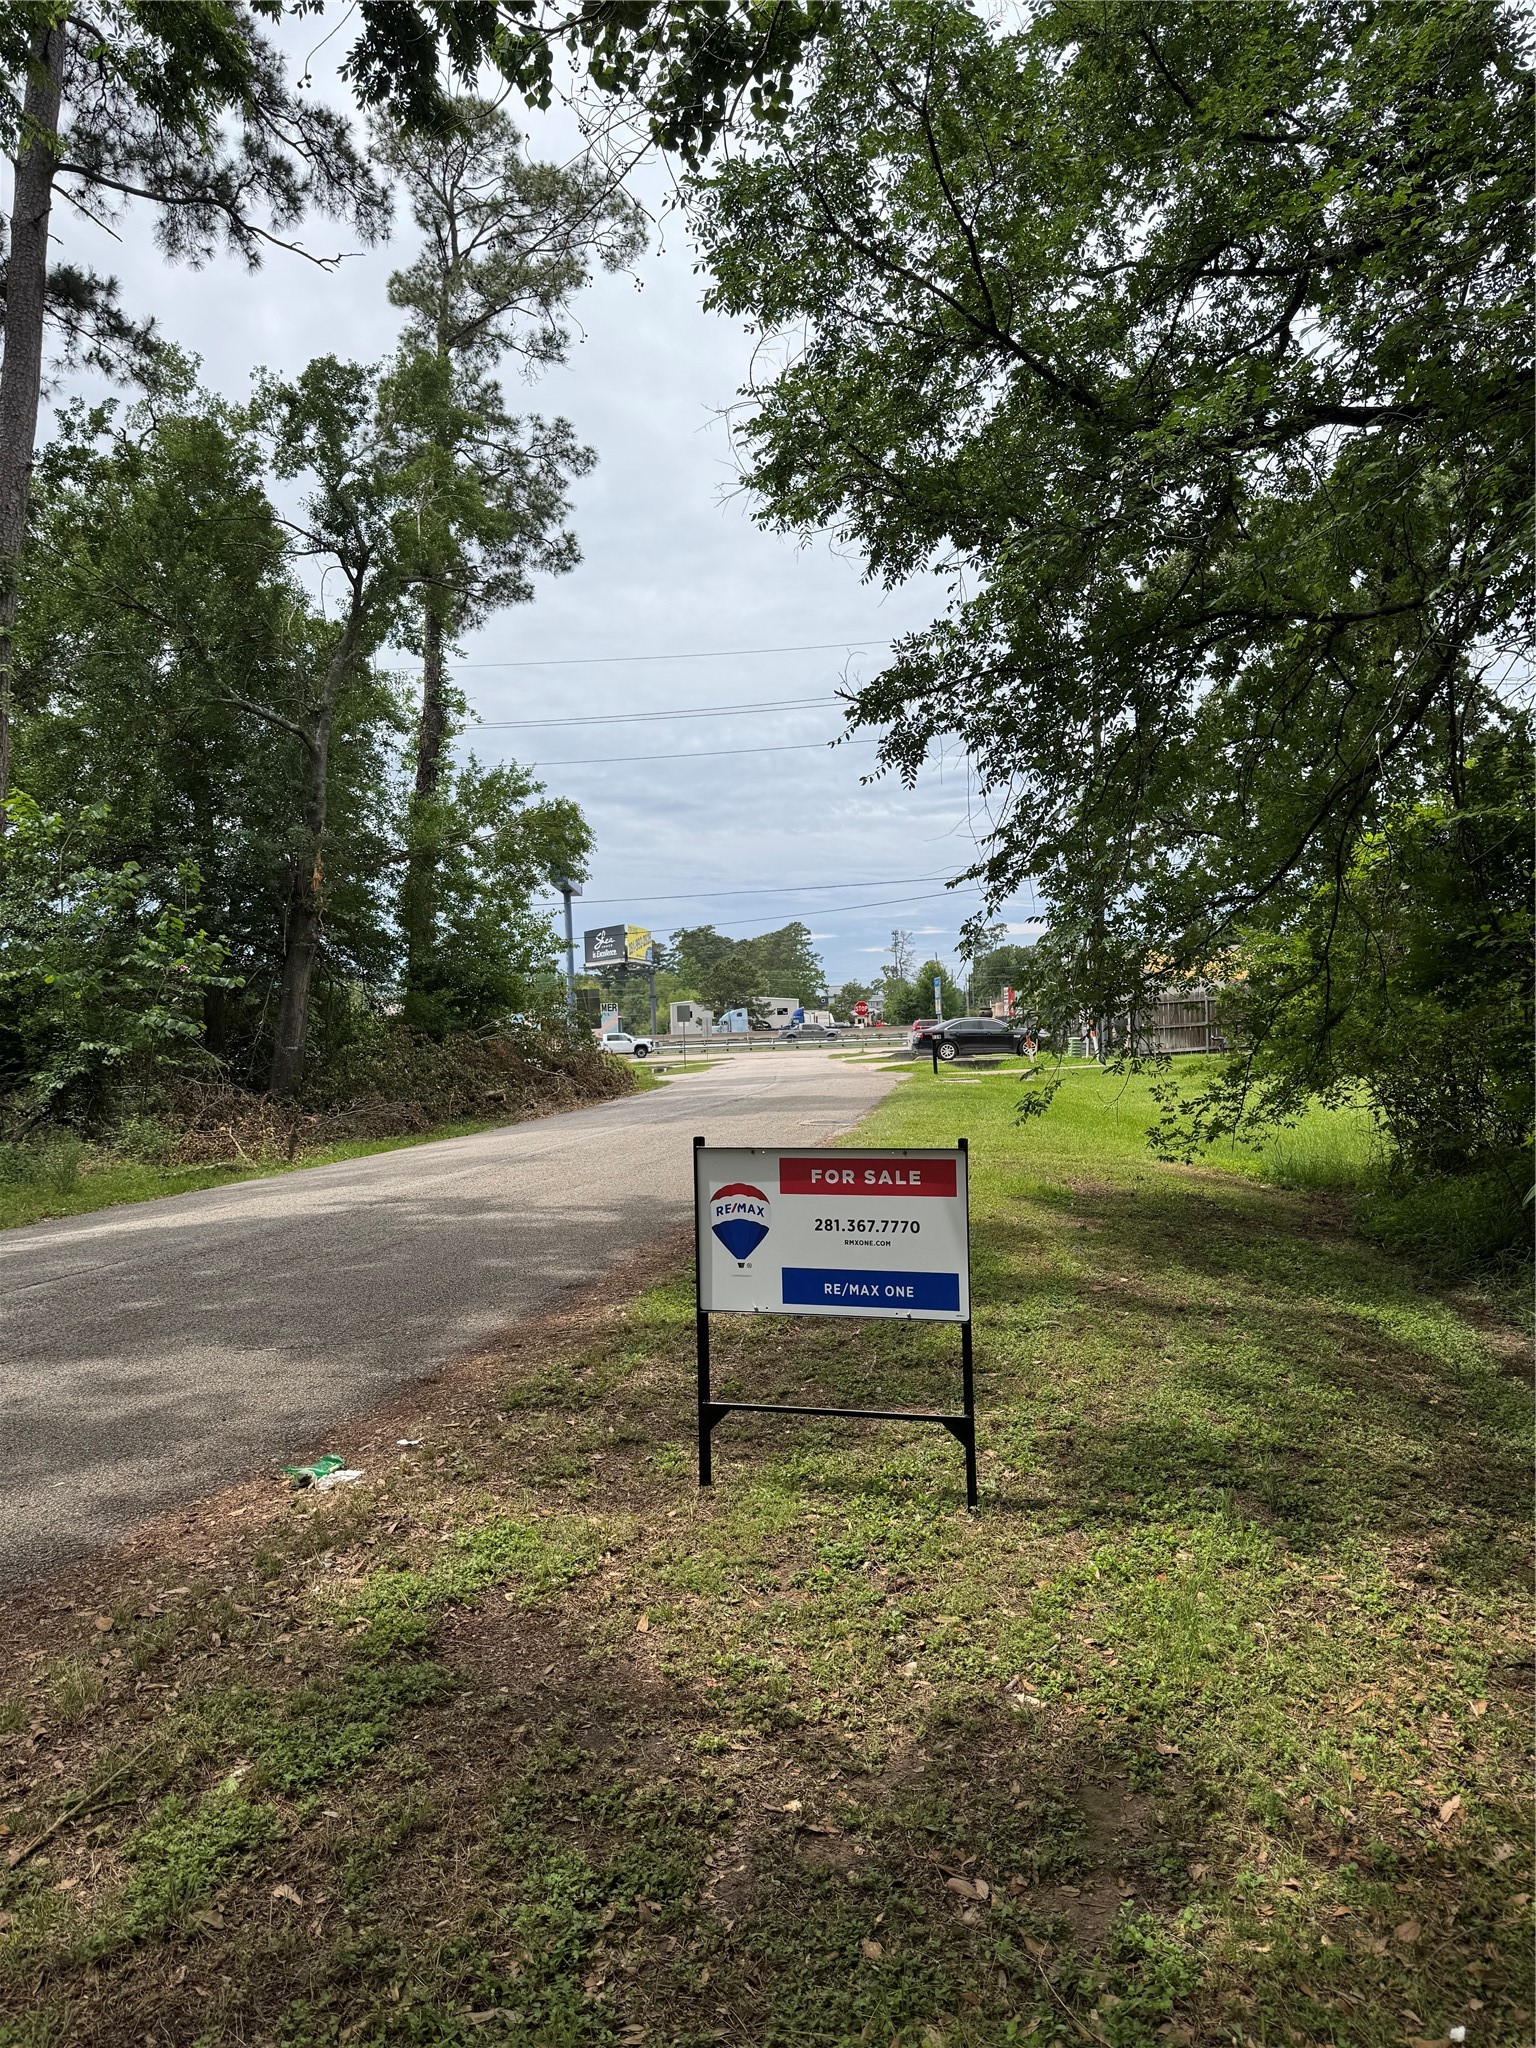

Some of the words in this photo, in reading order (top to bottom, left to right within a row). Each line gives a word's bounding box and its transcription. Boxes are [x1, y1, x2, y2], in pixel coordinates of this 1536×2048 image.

[594, 930, 616, 950] Shea
[811, 1169, 855, 1184] FOR
[864, 1169, 922, 1185] SALE
[715, 1202, 765, 1218] RE/MAX
[814, 1218, 921, 1234] 281.367.7770
[844, 1239, 891, 1247] RMXONE.COM
[823, 1283, 880, 1298] RE/MAX
[884, 1285, 914, 1298] ONE
